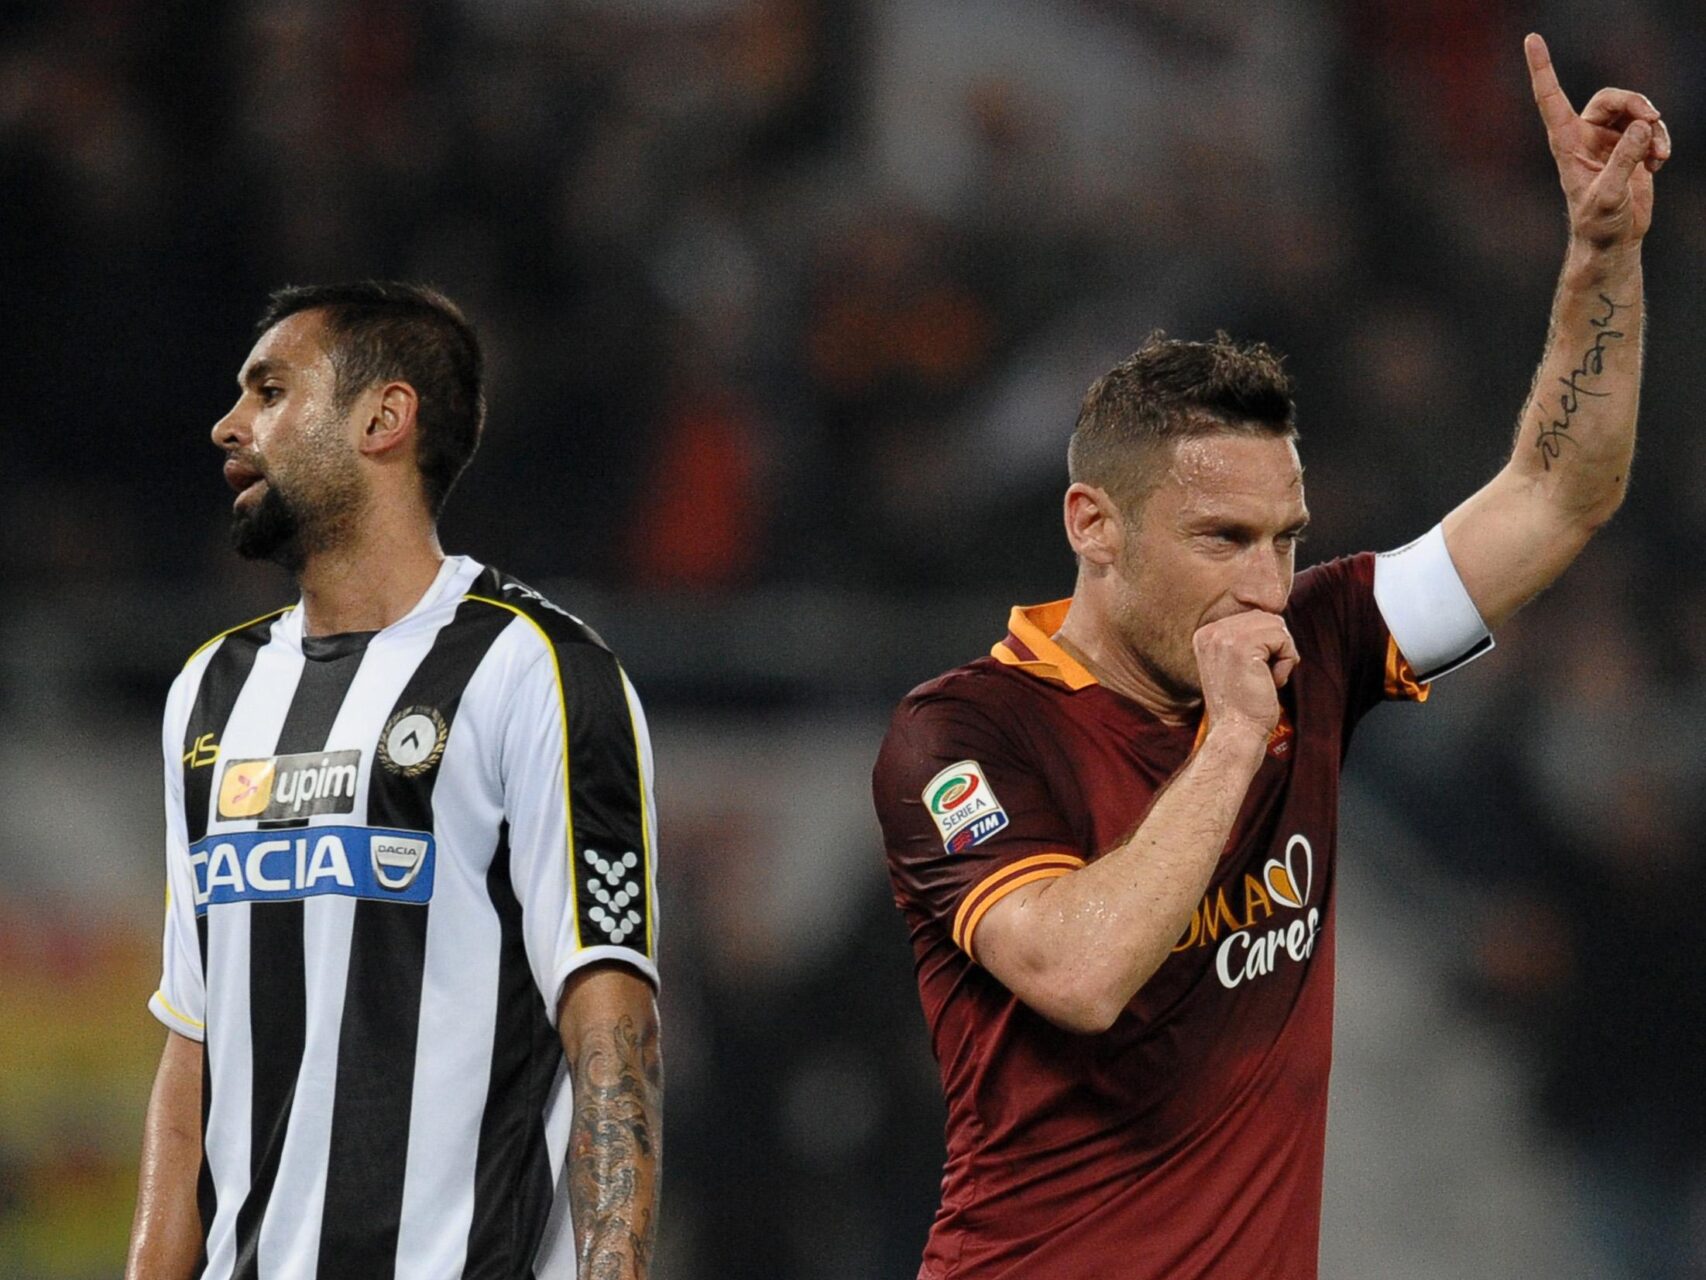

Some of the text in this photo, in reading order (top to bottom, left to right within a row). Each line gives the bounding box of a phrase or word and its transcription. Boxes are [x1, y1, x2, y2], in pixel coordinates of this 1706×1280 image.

[275, 758, 358, 813] upim
[942, 798, 987, 831] SERIE A
[970, 814, 1000, 838] TIM
[378, 844, 417, 856] DACIA
[1216, 907, 1321, 989] Cares
